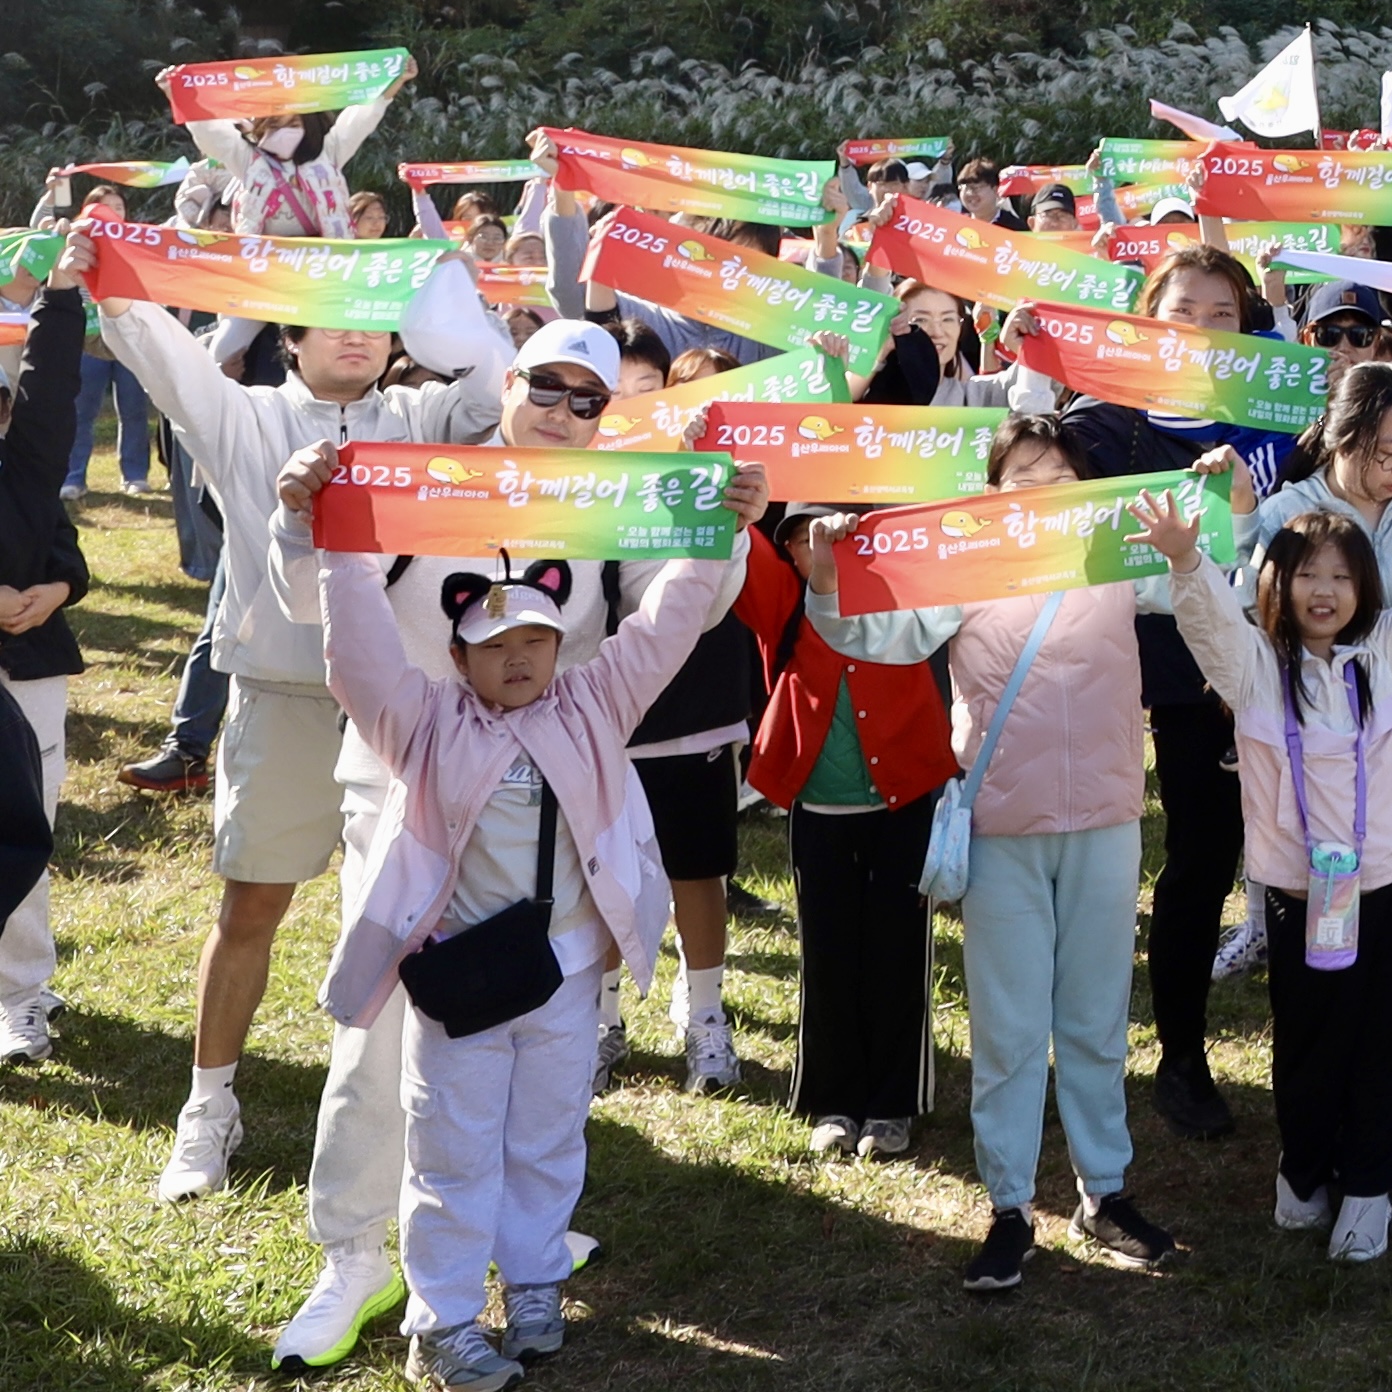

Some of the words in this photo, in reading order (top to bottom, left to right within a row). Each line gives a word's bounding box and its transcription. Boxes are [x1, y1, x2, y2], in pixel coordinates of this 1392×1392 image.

[182, 73, 228, 87] 2025
[1211, 157, 1263, 175] 2025
[89, 219, 162, 245] 2025
[241, 237, 359, 281] 함께걸어
[608, 223, 668, 253] 2025
[719, 256, 813, 311] 함께걸어
[894, 216, 947, 243] 2025
[994, 236, 1078, 291] 함께걸어
[1116, 240, 1160, 257] 2025
[1040, 317, 1094, 344] 2025
[1157, 329, 1261, 382] 함께걸어
[717, 425, 785, 445] 2025
[854, 416, 963, 459] 함께걸어
[331, 465, 411, 487] 2025
[495, 460, 629, 509] 함께걸어
[854, 528, 929, 555] 2025
[1002, 504, 1125, 551] 함께걸어
